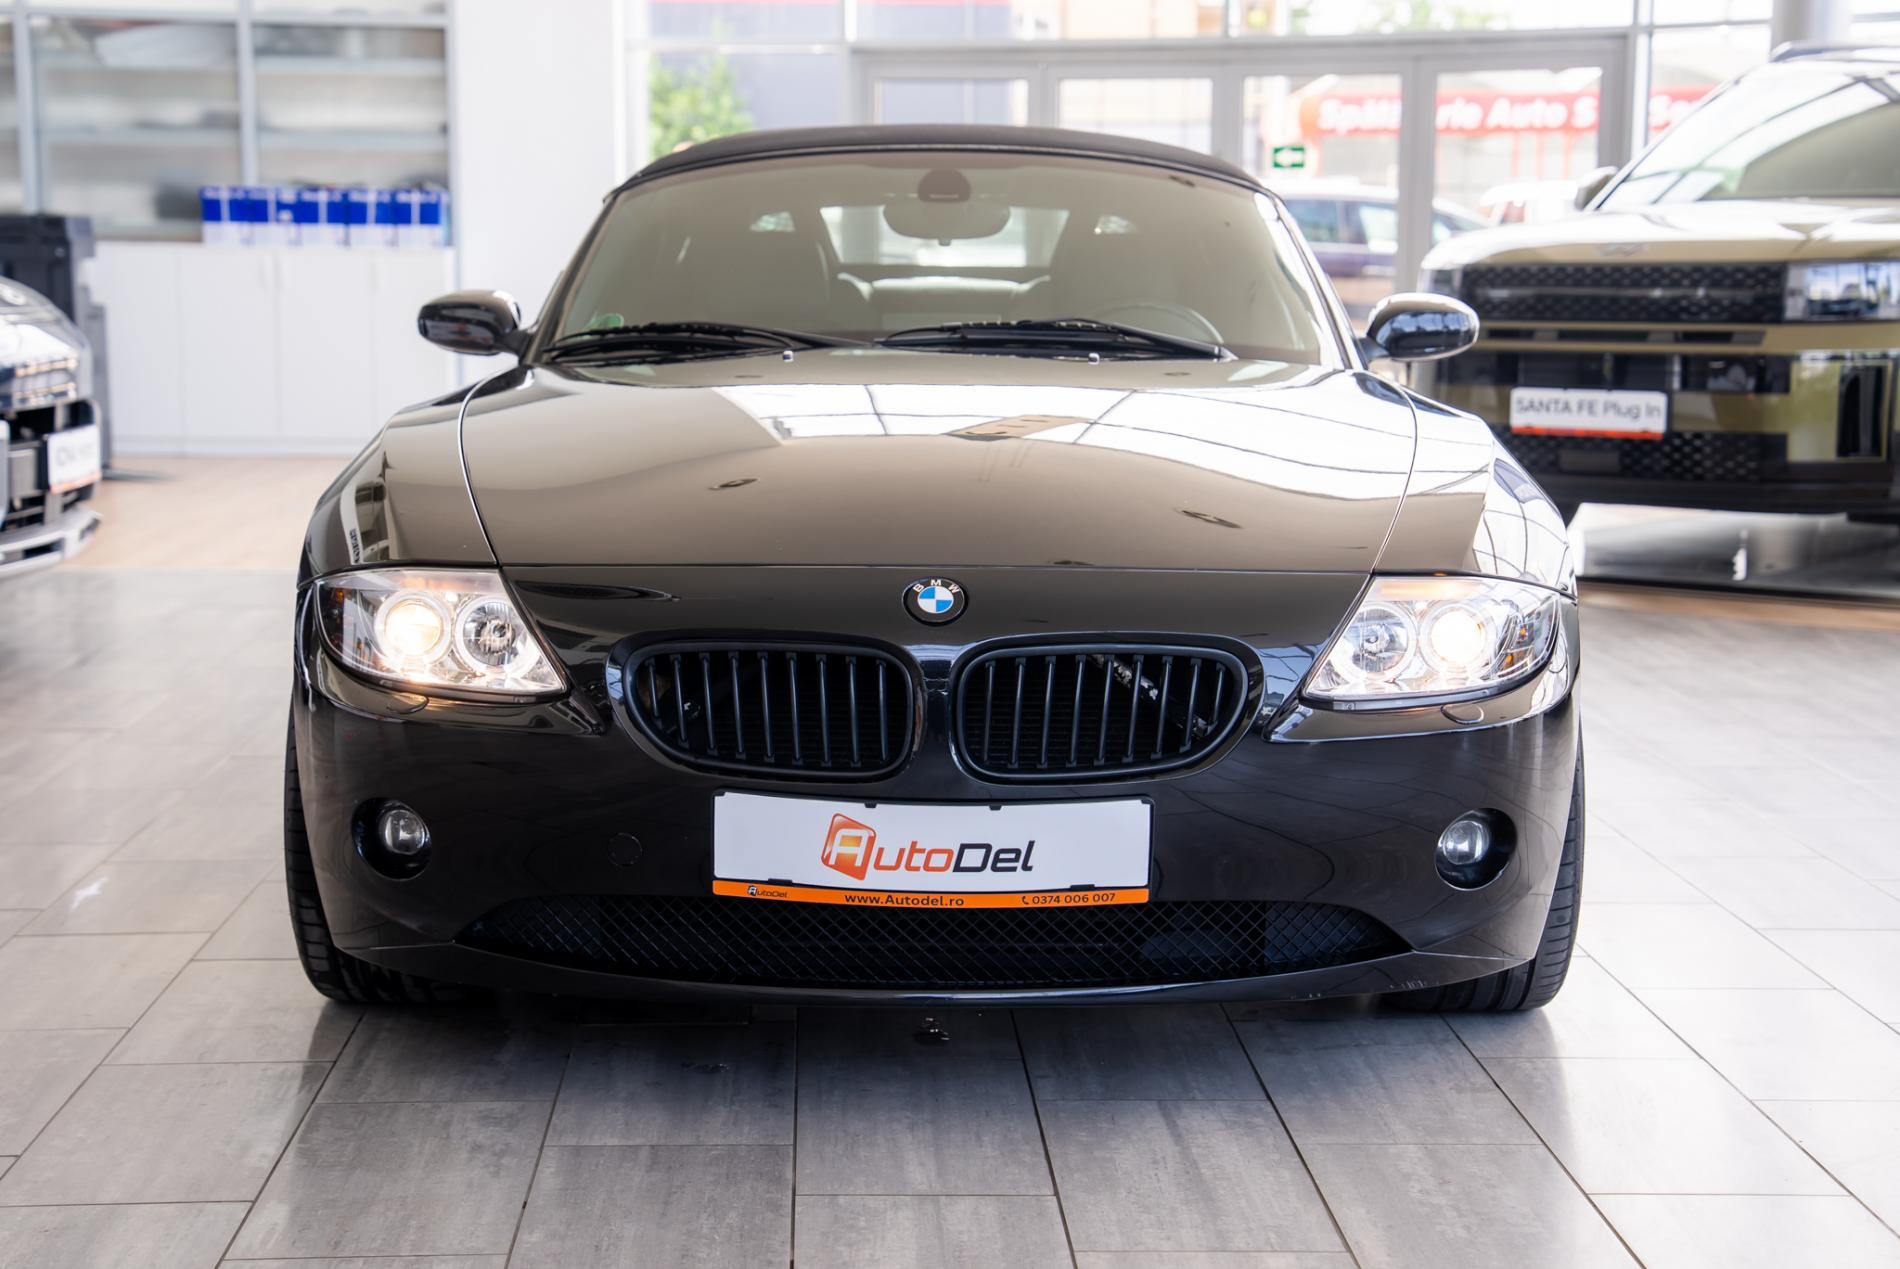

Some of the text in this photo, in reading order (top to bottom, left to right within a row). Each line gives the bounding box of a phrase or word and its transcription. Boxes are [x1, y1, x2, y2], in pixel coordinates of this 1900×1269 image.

[1486, 97, 1568, 129] Auto
[1516, 397, 1572, 415] SANTA
[1576, 398, 1598, 416] FE
[1603, 400, 1641, 421] Plug
[913, 579, 961, 594] BMW
[824, 821, 1035, 875] AutoDel
[747, 885, 788, 898] AutoDel
[1032, 893, 1116, 905] 0374 006 007
[844, 894, 965, 907] www.Autodel.ro
